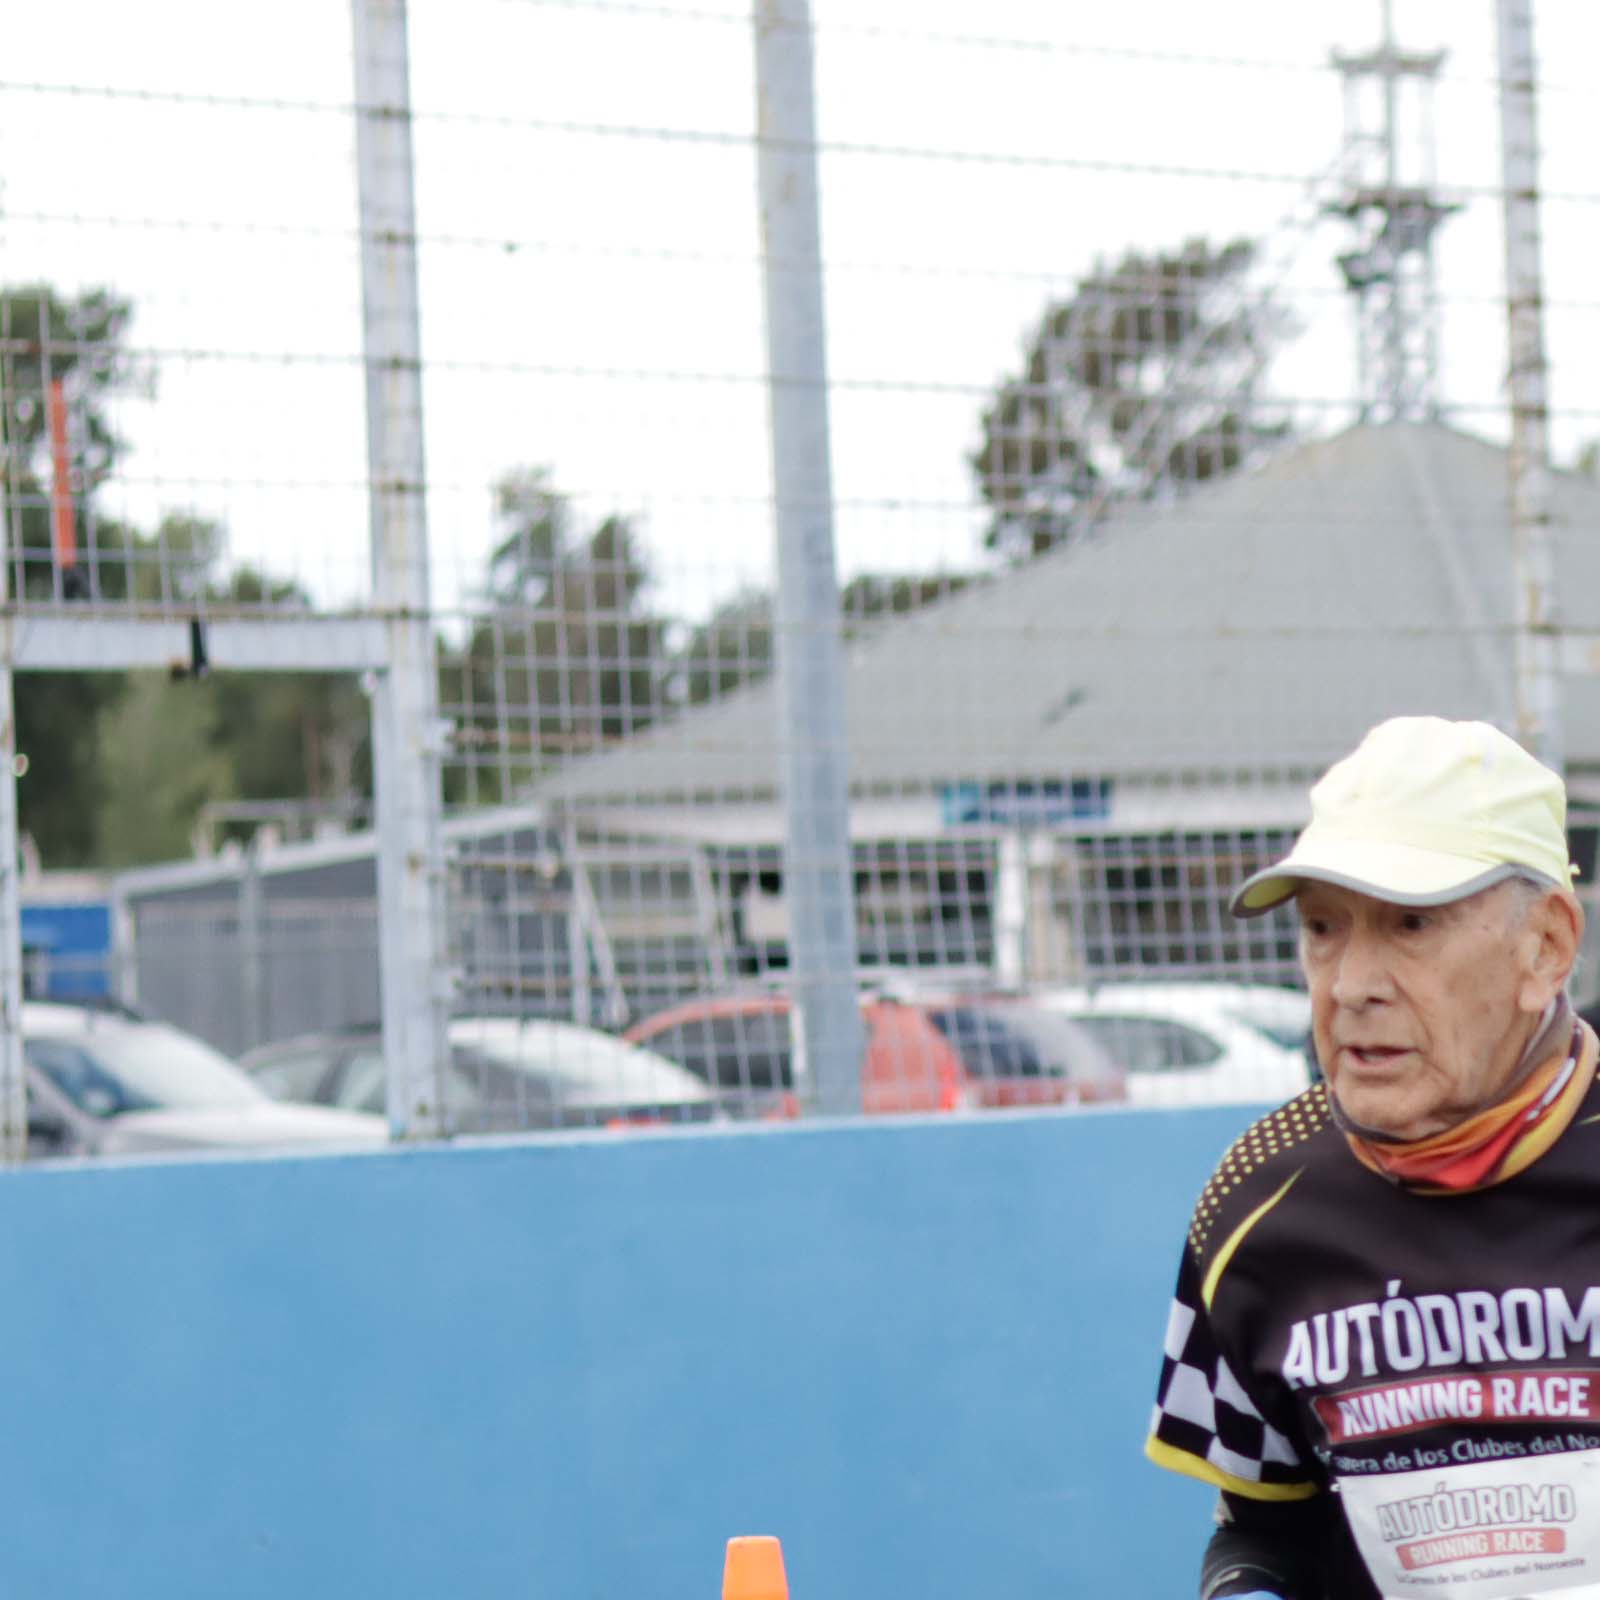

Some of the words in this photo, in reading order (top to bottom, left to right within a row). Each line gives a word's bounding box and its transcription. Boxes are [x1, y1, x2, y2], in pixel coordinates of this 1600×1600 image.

[1338, 1380, 1483, 1437] RUNNING
[1493, 1377, 1591, 1418] RACE
[1383, 1452, 1411, 1471] de
[1413, 1448, 1449, 1467] los
[1451, 1437, 1527, 1461] Clubes
[1529, 1434, 1564, 1452] del
[1376, 1481, 1576, 1542] AUTÓDROMO
[1410, 1532, 1489, 1566] RUNNING
[1493, 1531, 1545, 1552] RACE
